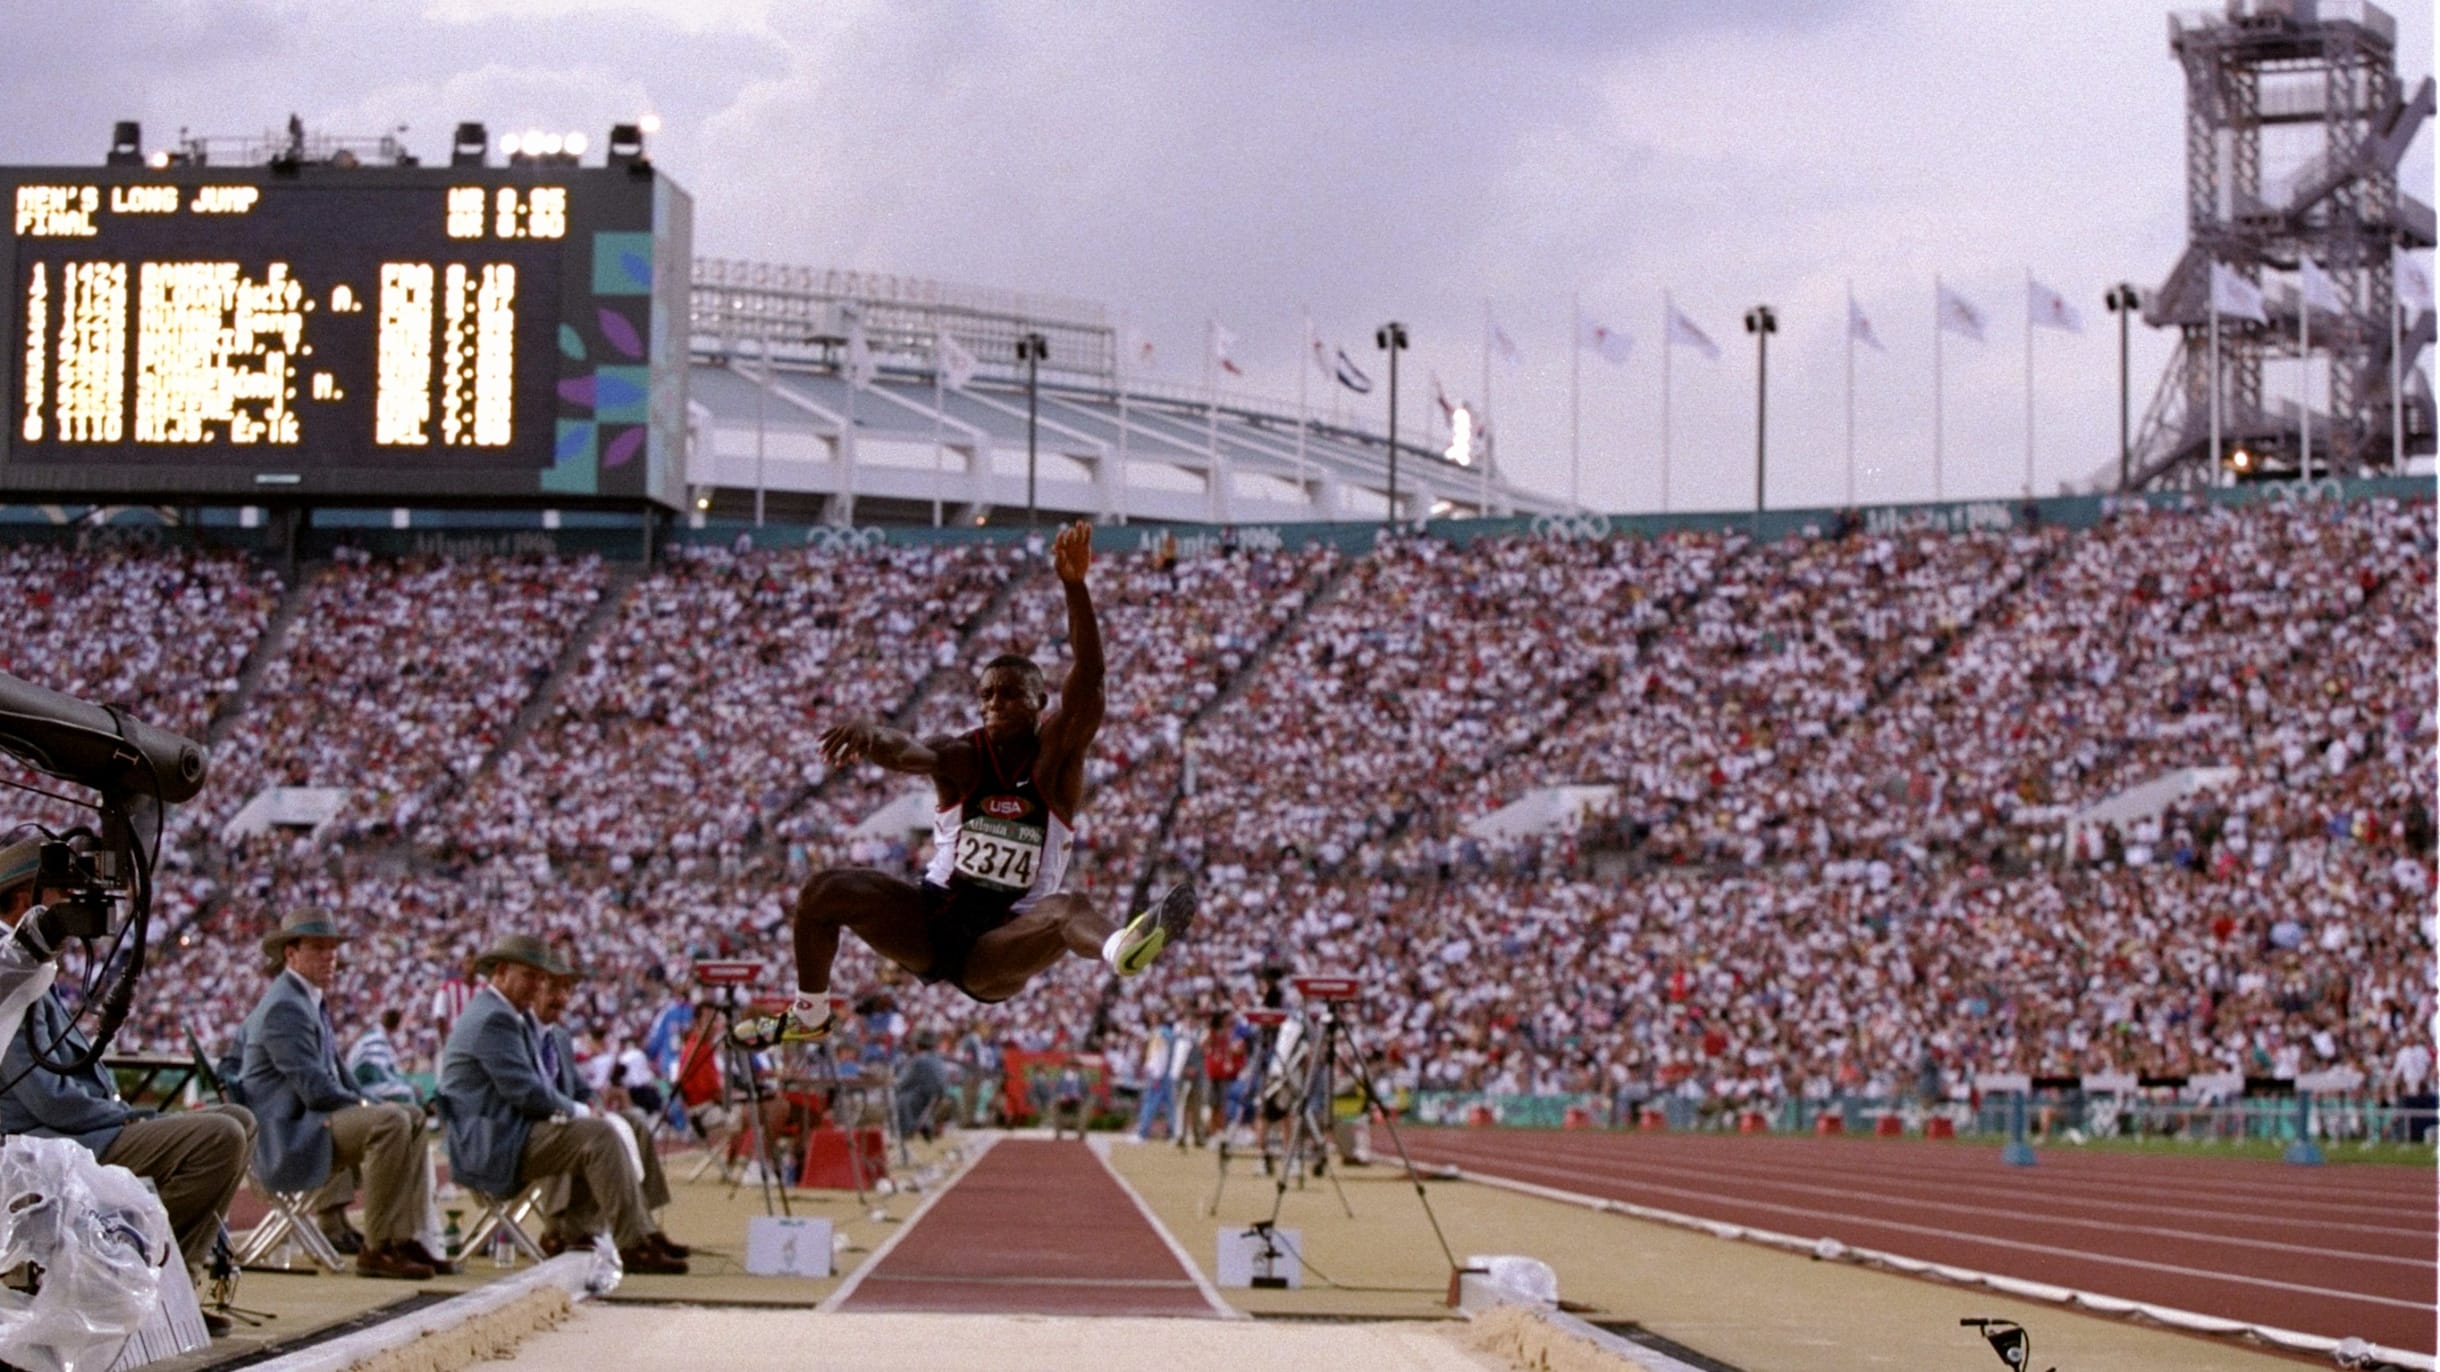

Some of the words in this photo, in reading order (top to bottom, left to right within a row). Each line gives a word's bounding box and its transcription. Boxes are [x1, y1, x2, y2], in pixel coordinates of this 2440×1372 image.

[17, 186, 98, 212] MEN'S
[111, 186, 178, 213] LONG
[191, 186, 259, 213] JUMP
[16, 210, 98, 236] FINAL
[989, 800, 1022, 814] USA
[968, 816, 1008, 836] Atlanta
[1019, 826, 1042, 843] 1996
[961, 837, 1032, 884] 2374
